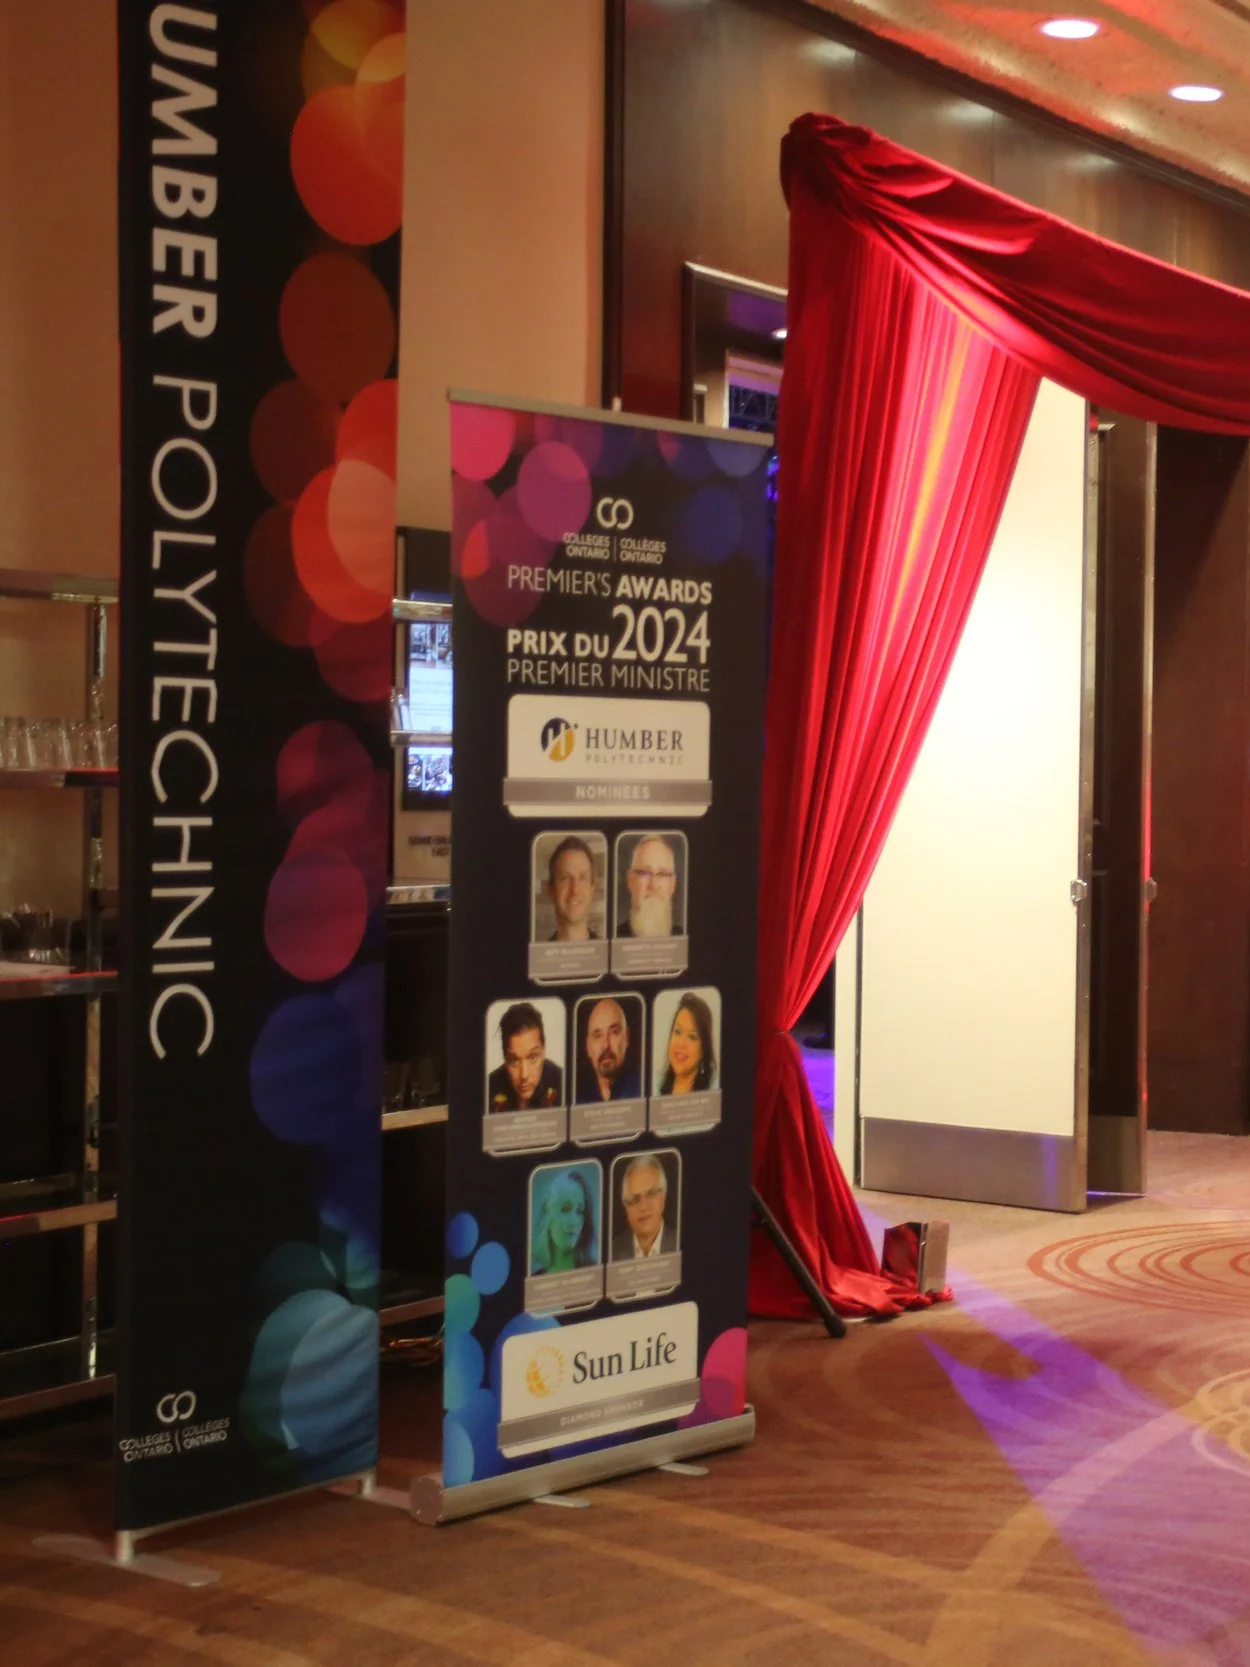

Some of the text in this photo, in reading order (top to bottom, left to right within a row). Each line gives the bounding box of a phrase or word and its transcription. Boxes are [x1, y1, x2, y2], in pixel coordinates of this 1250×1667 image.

[562, 532, 610, 547] COLLEGES
[566, 545, 610, 560] ONTARIO
[620, 550, 664, 564] ONTARIO
[508, 565, 712, 605] PREMIER'S AWARDS
[507, 603, 711, 664] PRIX DU 2024
[507, 659, 711, 692] PREMIER MINISTRE
[150, 375, 219, 1060] POLYTECHNIC
[585, 728, 683, 751] HUMBER
[585, 754, 684, 765] POLYTECHNIC
[576, 785, 650, 799] NOMINEES
[573, 1332, 677, 1384] Sun Life
